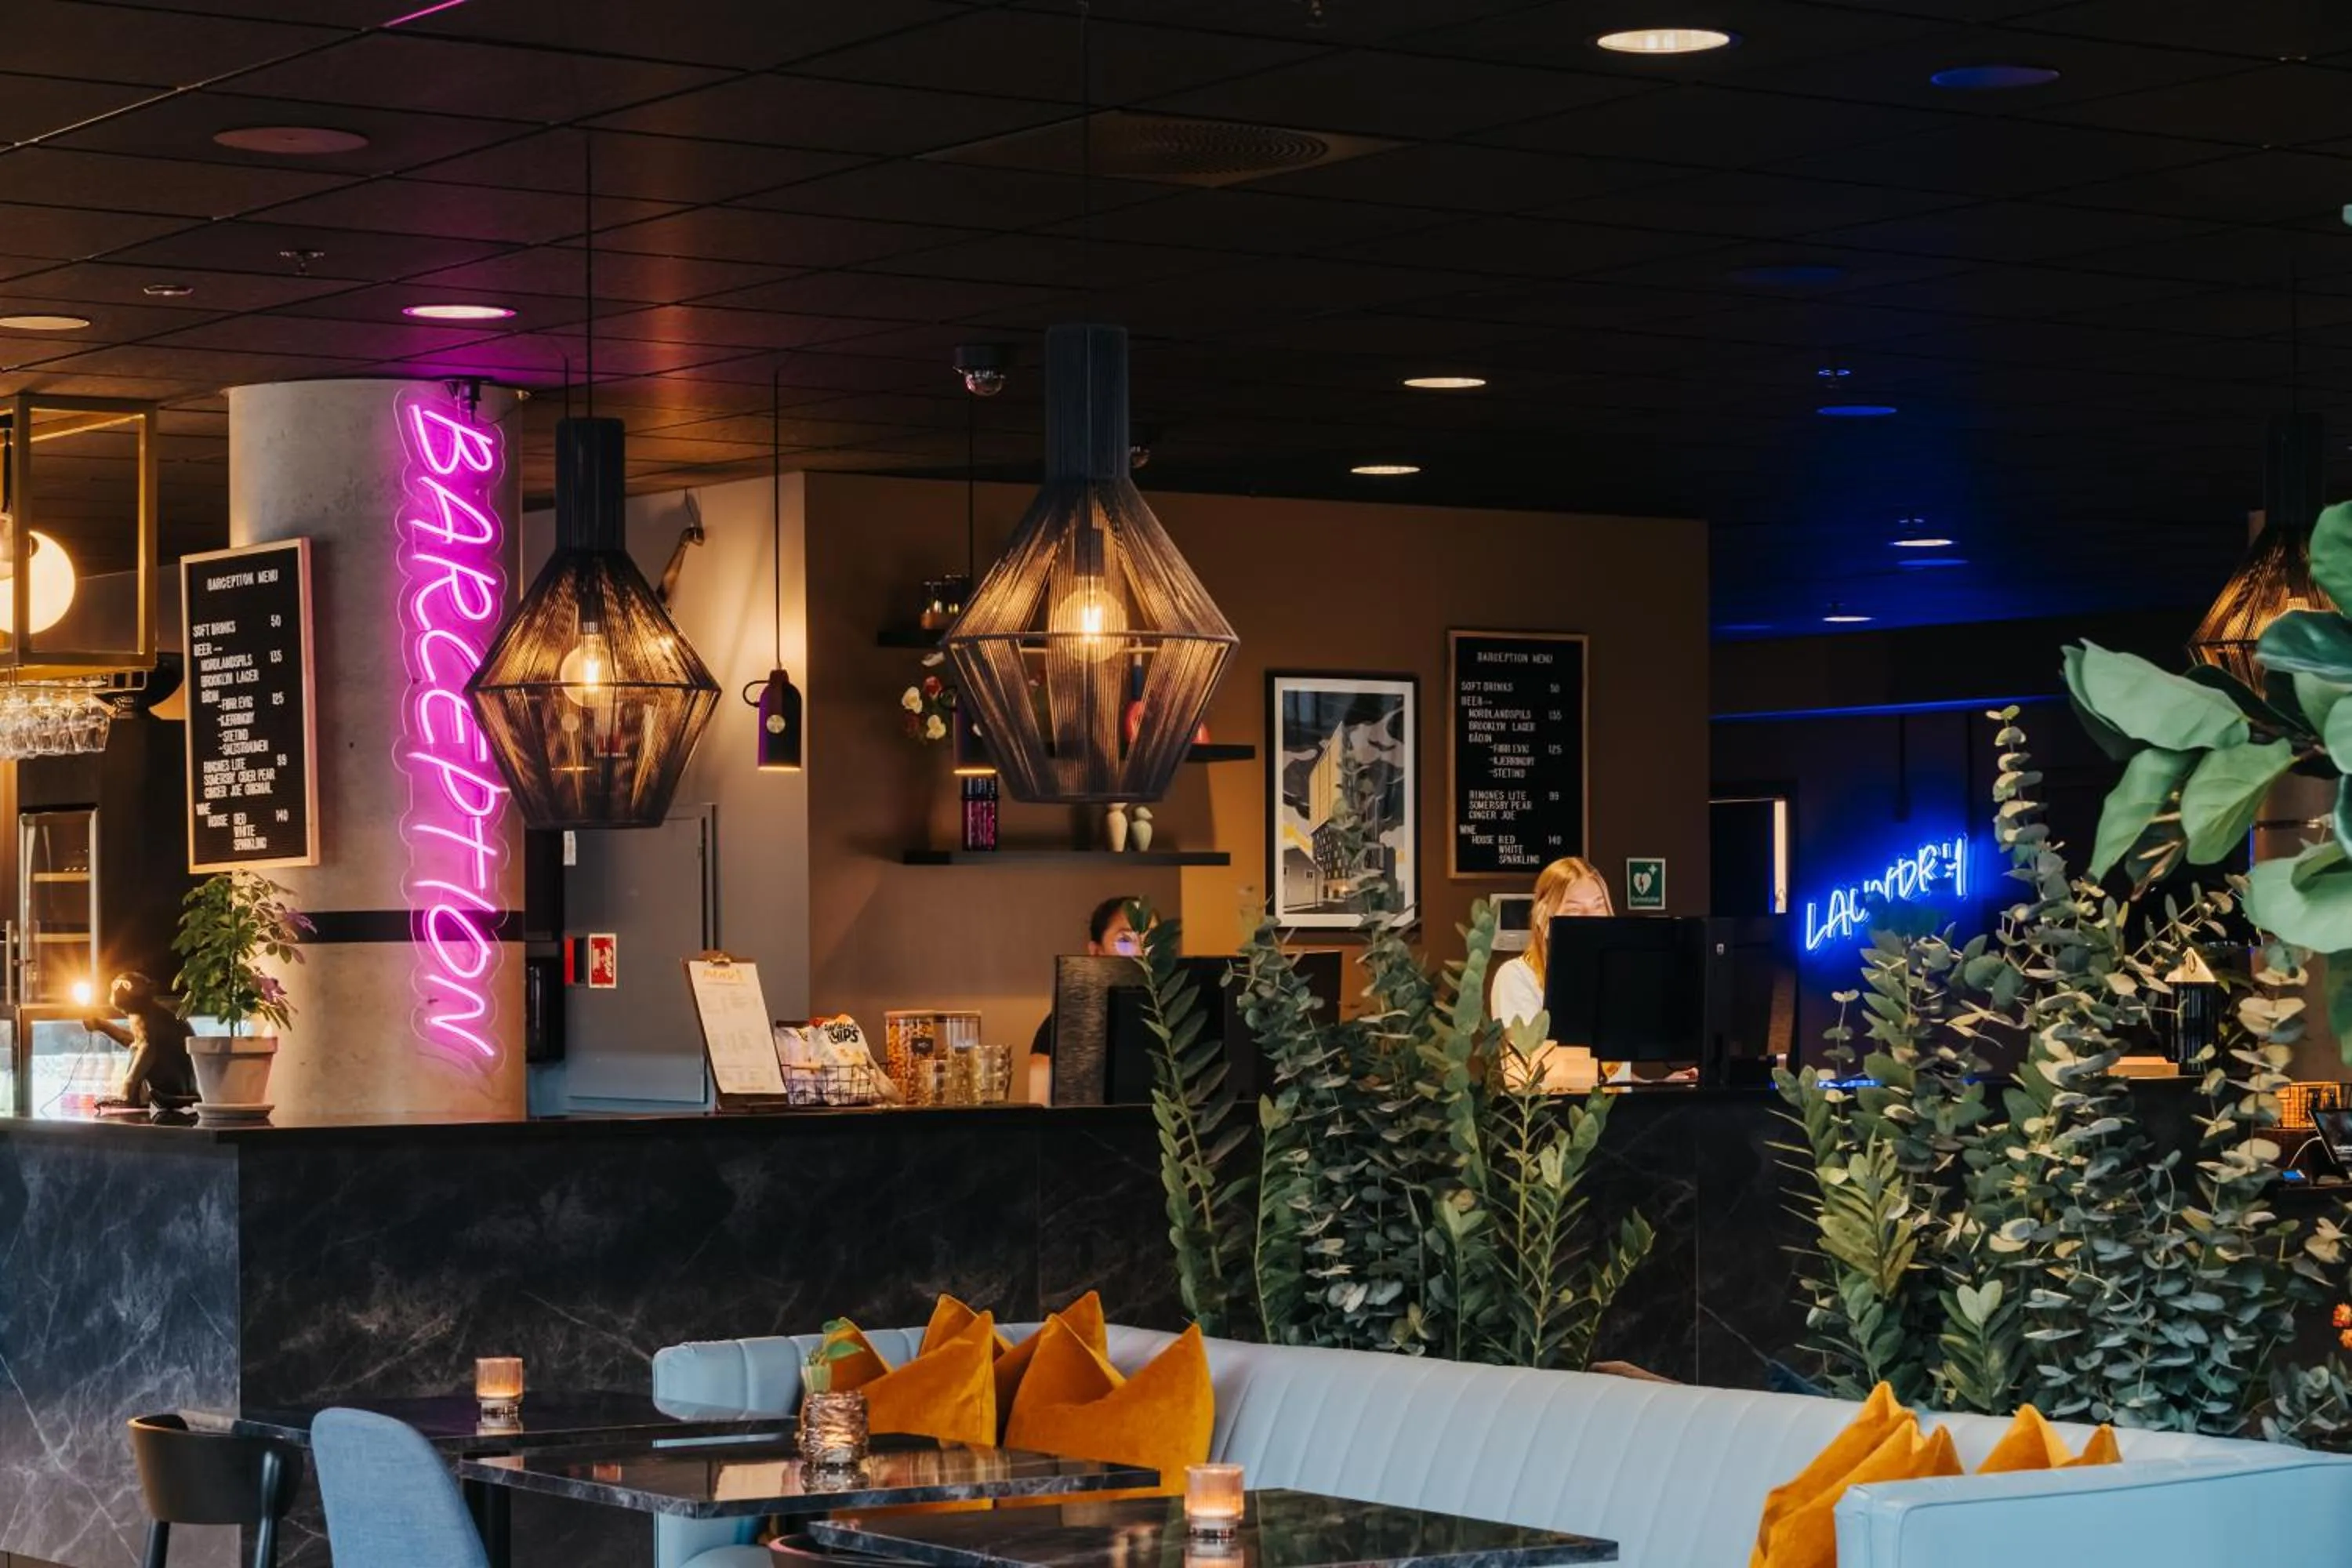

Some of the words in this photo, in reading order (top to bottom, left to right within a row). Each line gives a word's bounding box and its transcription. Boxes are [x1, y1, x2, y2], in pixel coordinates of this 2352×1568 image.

[207, 572, 254, 591] BARCEPTION
[258, 568, 278, 583] MENU
[193, 623, 210, 637] SOFT
[211, 620, 236, 636] DRINKS
[270, 614, 281, 627] 50
[270, 648, 282, 663] 135
[1477, 652, 1528, 663] BARCEPTION
[1532, 654, 1553, 664] MENU
[236, 669, 260, 684] LAGER
[1461, 681, 1481, 691] SOFT
[1483, 682, 1513, 692] DRINKS
[272, 691, 284, 705] 125
[407, 404, 510, 1056] BARCEPTION
[1468, 721, 1505, 731] BROOKLYN
[1548, 743, 1563, 754] 125
[230, 757, 246, 771] LITE
[257, 768, 275, 781] PEAR
[230, 784, 243, 797] JOE
[1468, 789, 1504, 800] RINGNES
[1508, 790, 1526, 800] LITE
[1468, 800, 1508, 810] SOMERSBY
[1511, 800, 1532, 811] PEAR
[207, 813, 228, 828] HOUSE
[233, 812, 247, 826] RED
[275, 808, 289, 822] 140
[1468, 811, 1497, 820] GINGER
[1501, 811, 1516, 820] JOE
[233, 824, 256, 838] WHITE
[1472, 835, 1494, 844] HOUSE
[1498, 834, 1516, 844] RED
[1498, 844, 1523, 855] WHITE
[1498, 855, 1540, 865] SPARKLING
